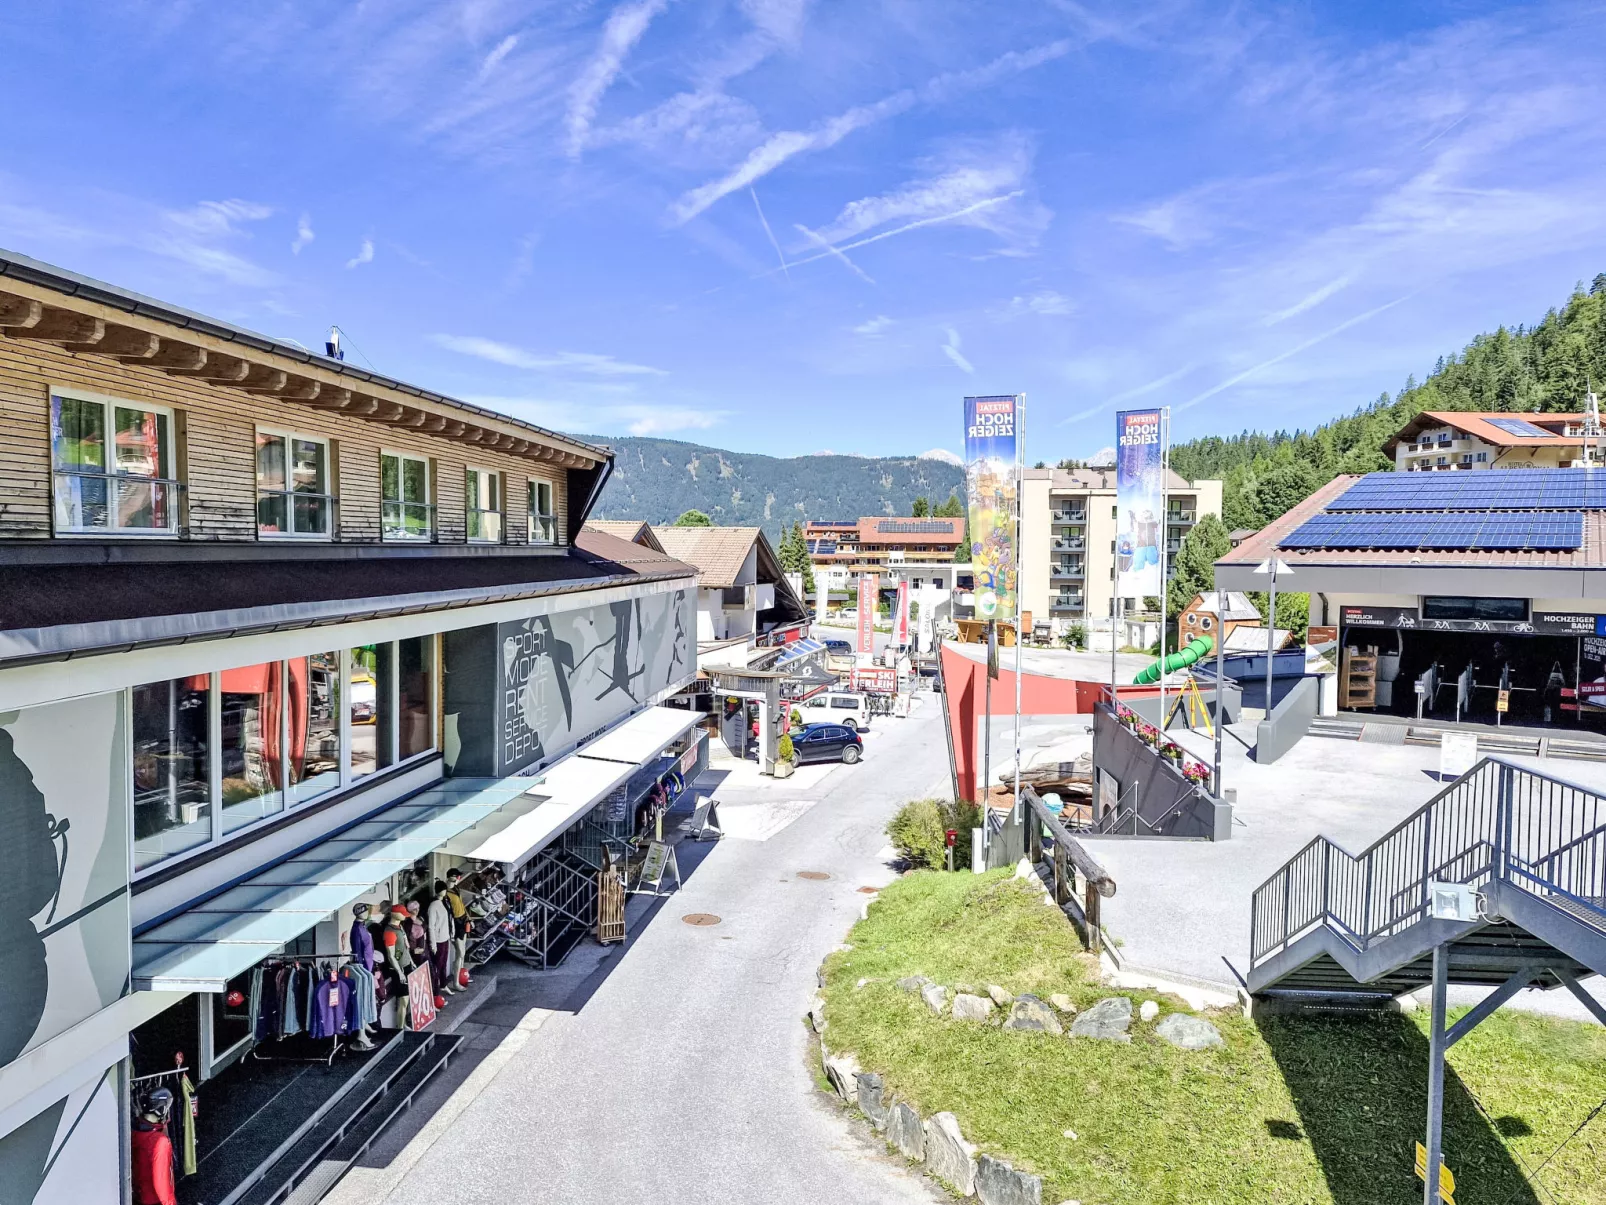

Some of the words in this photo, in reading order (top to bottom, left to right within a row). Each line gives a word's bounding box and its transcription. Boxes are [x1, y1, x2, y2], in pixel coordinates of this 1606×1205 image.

[863, 580, 872, 616] SERVICE
[863, 619, 872, 652] VERLEIH
[1543, 615, 1595, 623] HOCHZEIGER
[1571, 622, 1595, 630] BAHN
[503, 629, 548, 659] SPORT
[505, 652, 548, 688] MODE
[878, 671, 894, 680] SKI
[505, 678, 548, 720] RENT
[504, 706, 548, 740] SERVICE
[504, 725, 548, 766] DEPOT
